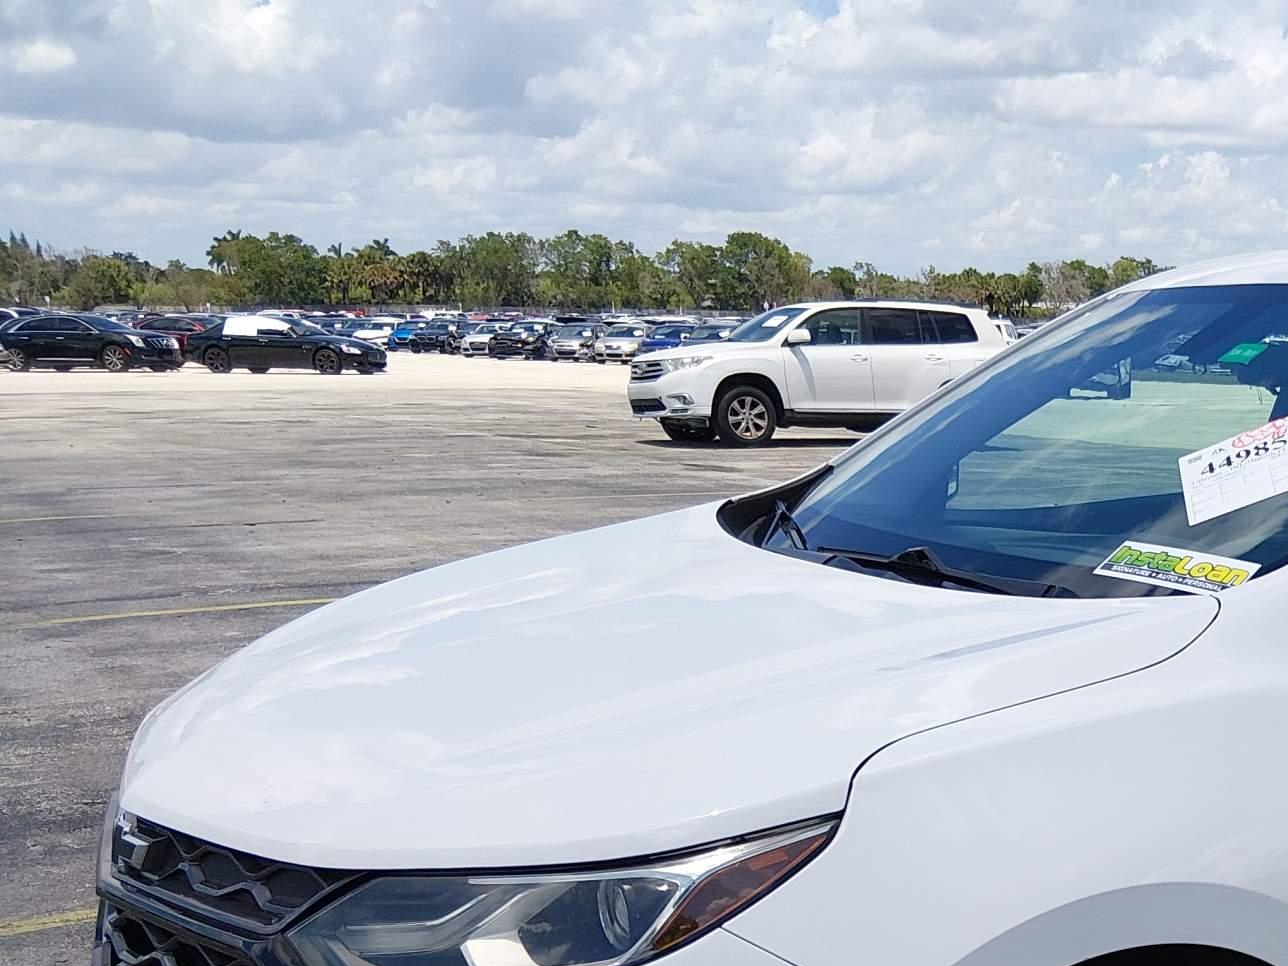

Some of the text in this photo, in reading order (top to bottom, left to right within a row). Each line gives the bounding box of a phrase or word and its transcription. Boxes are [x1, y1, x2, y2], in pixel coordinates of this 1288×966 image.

[1110, 545, 1250, 587] InstaLoan
[1111, 565, 1223, 592] SIGNATURE AUTO PERSONAL
